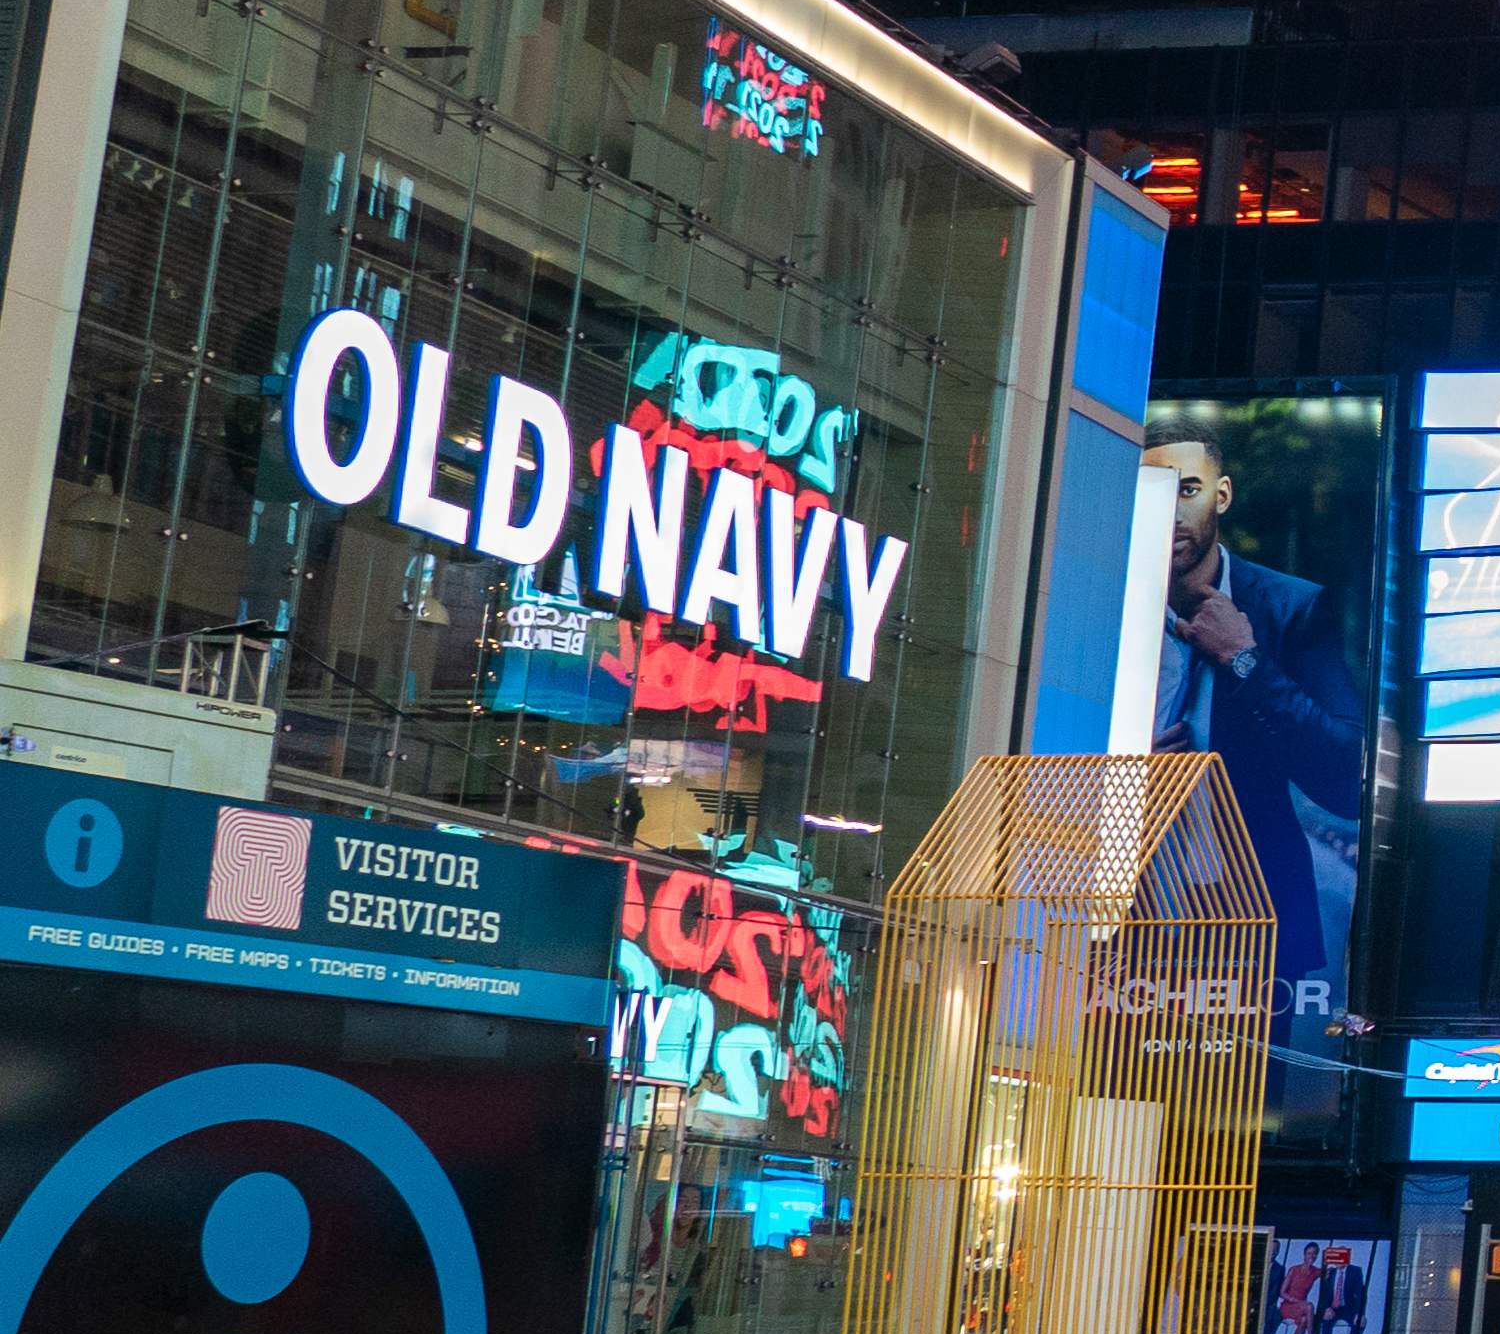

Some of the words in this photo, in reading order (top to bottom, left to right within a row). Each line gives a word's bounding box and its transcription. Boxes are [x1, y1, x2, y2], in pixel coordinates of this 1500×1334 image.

[290, 307, 573, 565] OLD
[592, 423, 908, 682] NAVY
[334, 835, 481, 891] VISITOR
[326, 889, 501, 945] SERVICES
[28, 925, 82, 948] FREE
[87, 932, 165, 956] GUIDES
[186, 943, 235, 964] FREE
[239, 949, 289, 970] MAPS
[310, 957, 387, 981] TICKETS
[404, 969, 521, 997] INFORMATION
[1086, 977, 1331, 1017] ACHELOR
